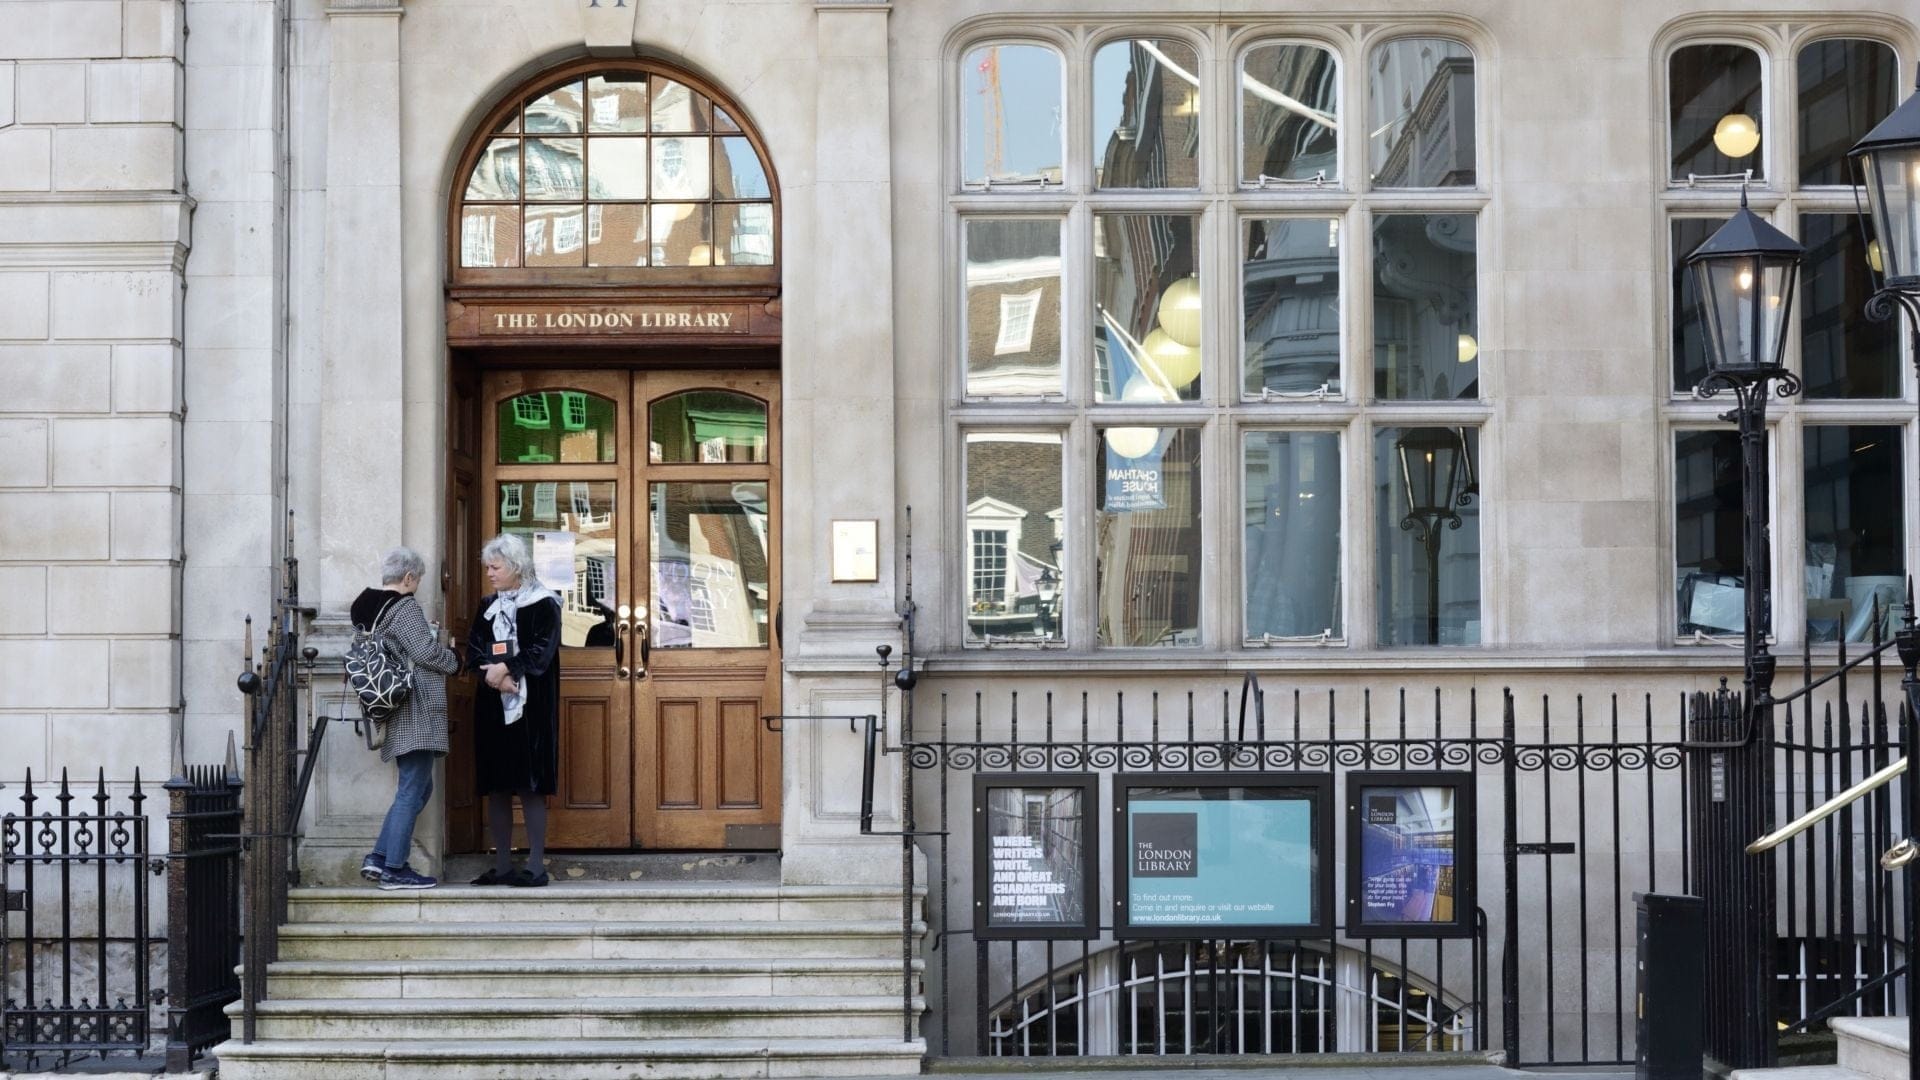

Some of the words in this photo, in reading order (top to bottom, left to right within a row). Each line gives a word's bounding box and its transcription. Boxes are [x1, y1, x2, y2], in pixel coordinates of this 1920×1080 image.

[494, 313, 538, 328] THE
[545, 313, 634, 328] LONDON
[641, 312, 733, 327] LIBRARY
[993, 836, 1032, 847] WHERE
[993, 848, 1043, 859] WRITERS
[1138, 850, 1192, 860] LONDON
[993, 860, 1032, 871] WRITE,
[1138, 861, 1191, 871] LIBRARY
[993, 872, 1016, 882] AND
[1017, 872, 1052, 882] GREAT
[993, 883, 1066, 894] CHARACTERS
[993, 896, 1016, 906] ARE
[1017, 896, 1047, 906] BORN
[1132, 893, 1141, 901] To
[1143, 893, 1157, 901] find
[1132, 903, 1153, 911] Come
[1155, 903, 1162, 911] in
[1164, 903, 1178, 911] and
[1180, 903, 1206, 913] enquire
[1218, 903, 1232, 911] visit
[1247, 903, 1275, 911] website
[1132, 913, 1222, 923] www.londonlibrary.co.uk
